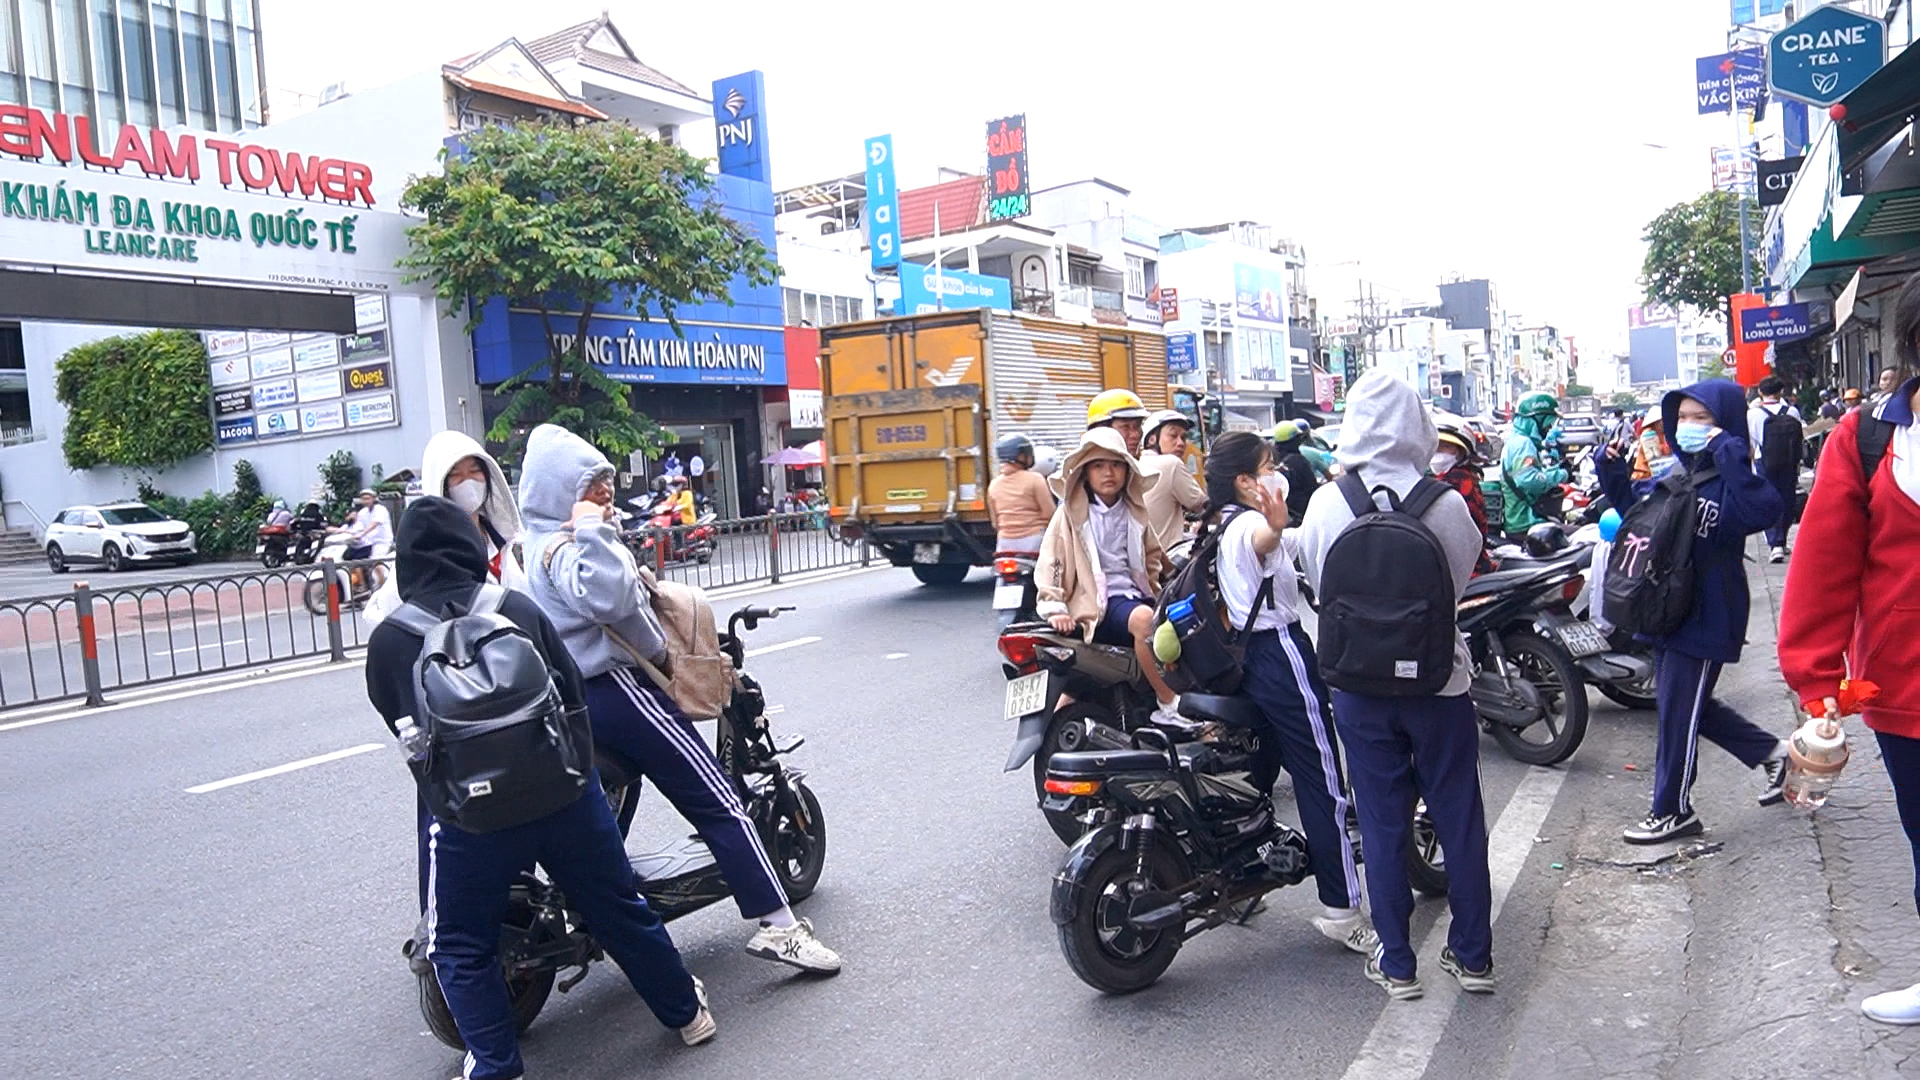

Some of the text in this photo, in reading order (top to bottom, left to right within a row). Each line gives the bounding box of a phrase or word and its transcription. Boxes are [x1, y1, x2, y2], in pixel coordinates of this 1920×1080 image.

[1781, 25, 1866, 53] CRANE
[1808, 52, 1840, 66] TEA
[1699, 87, 1760, 107] VẮC XIN
[718, 118, 753, 148] PNJ
[74, 114, 200, 180] LAM
[205, 138, 376, 205] TOWER
[1, 179, 359, 254] KHÁM ĐA KHOA QUỐC TẾ
[991, 194, 1027, 218] 24/24
[84, 228, 199, 262] LEANCARE
[1745, 324, 1807, 340] LONG CHÂU
[616, 327, 656, 366] TÂM
[659, 339, 691, 367] KIM
[693, 332, 738, 369] HOÀN
[740, 343, 765, 374] PNJ
[349, 368, 385, 389] Quest
